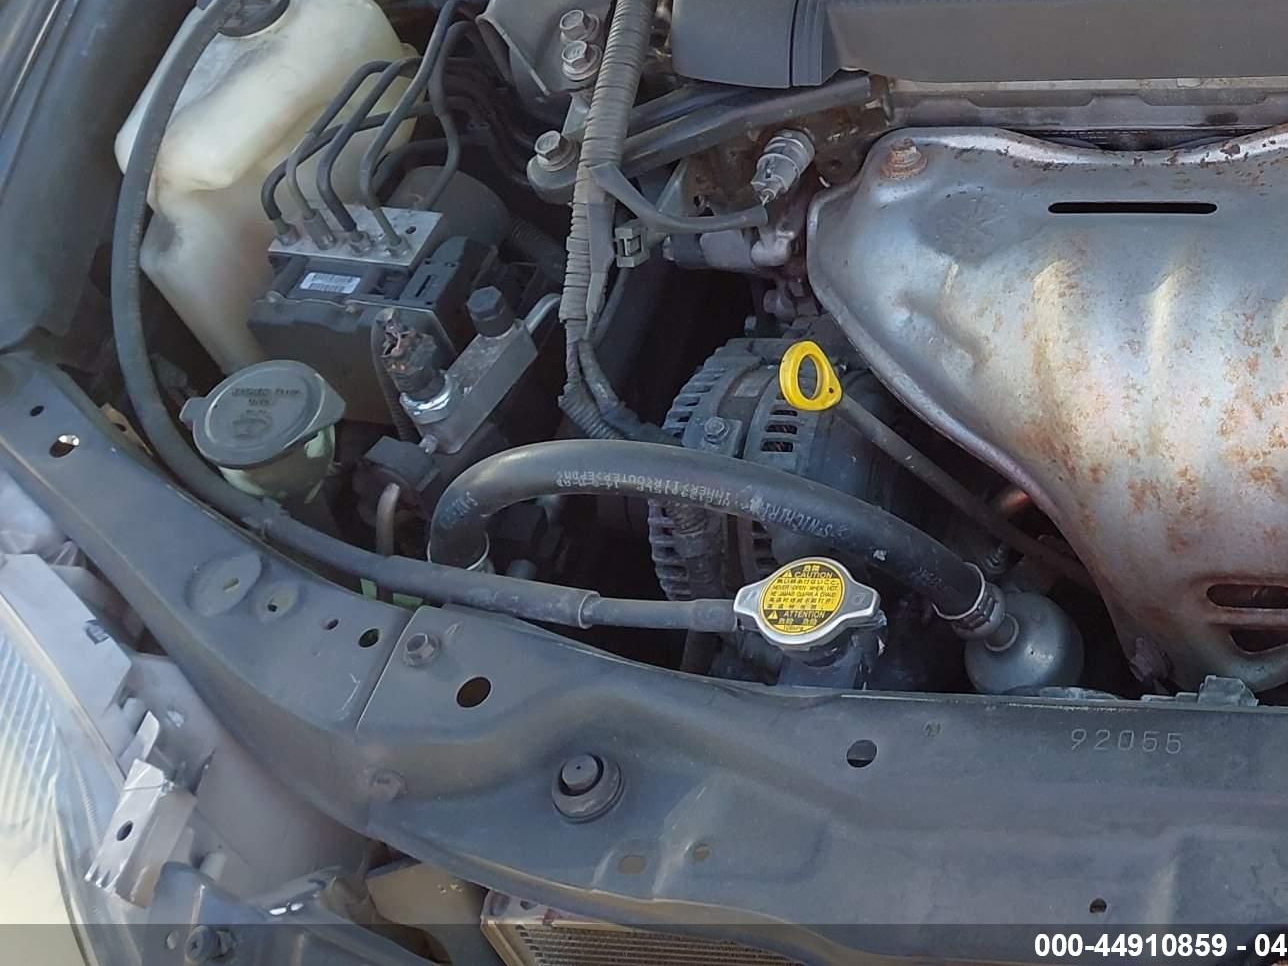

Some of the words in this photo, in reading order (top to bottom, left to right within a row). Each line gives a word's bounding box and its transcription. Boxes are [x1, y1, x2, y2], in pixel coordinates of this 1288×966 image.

[794, 571, 833, 579] CAUTION
[783, 611, 826, 619] ATTENTION
[1070, 728, 1184, 755] 92055
